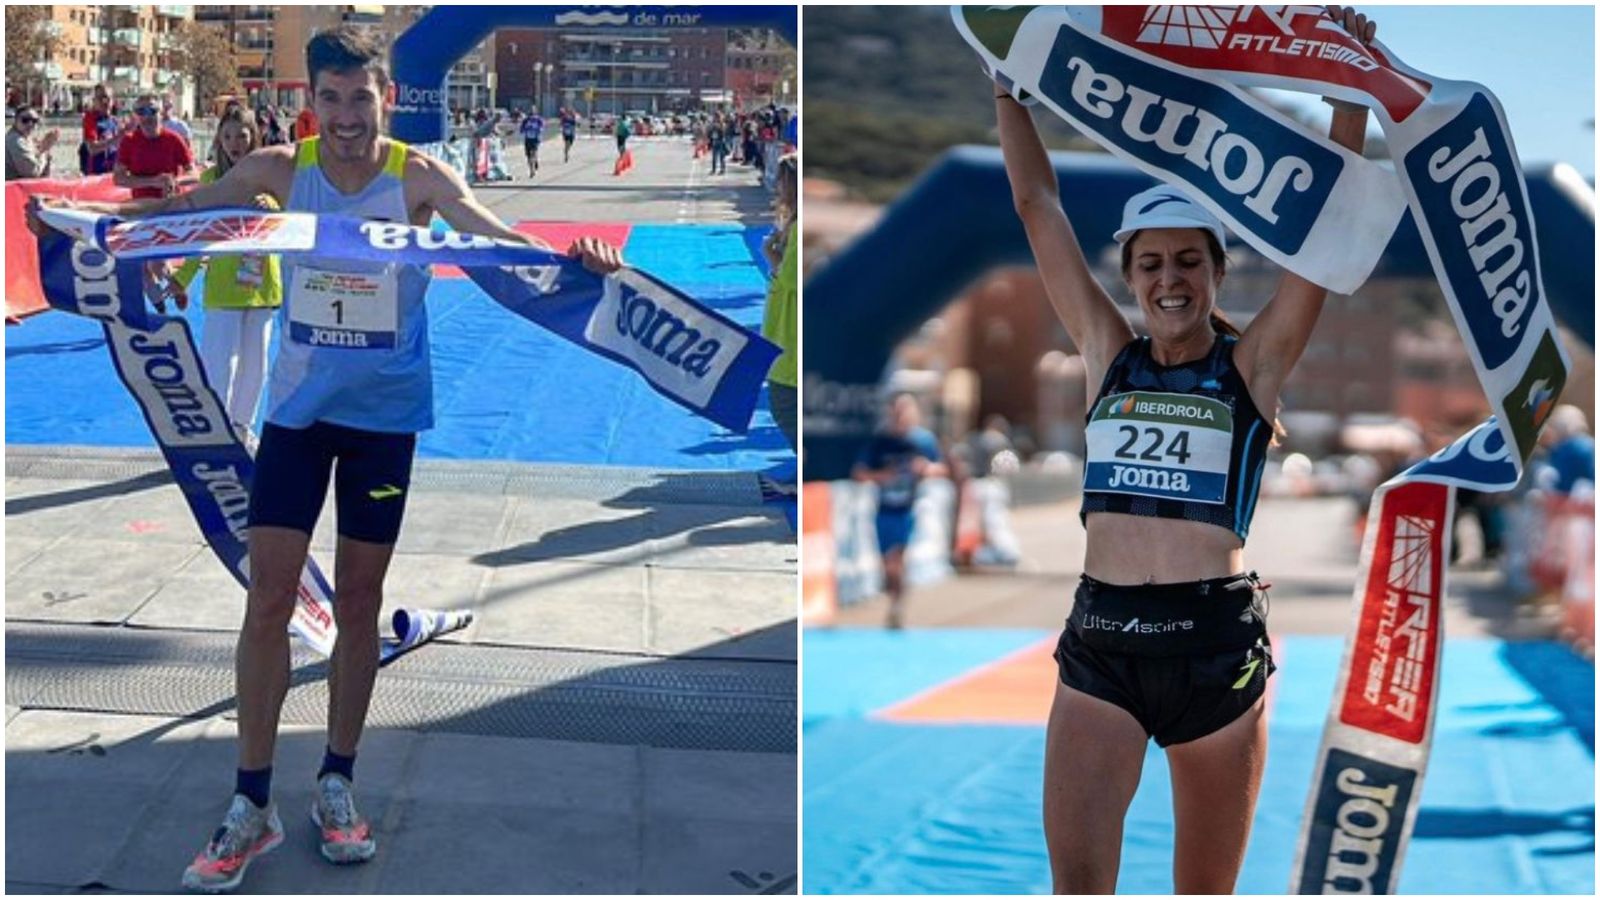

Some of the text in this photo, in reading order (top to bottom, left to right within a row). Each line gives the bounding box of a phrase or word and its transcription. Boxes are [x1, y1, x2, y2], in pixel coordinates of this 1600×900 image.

[634, 11, 701, 26] de mar
[1227, 33, 1381, 72] ATLETISMO
[1428, 126, 1531, 338] Joma
[331, 299, 344, 325] 1
[617, 282, 722, 378] Joma
[129, 334, 212, 437] Joma
[1135, 401, 1214, 421] IBERDROLA
[1115, 425, 1191, 464] 224
[1322, 767, 1398, 895] Jom
